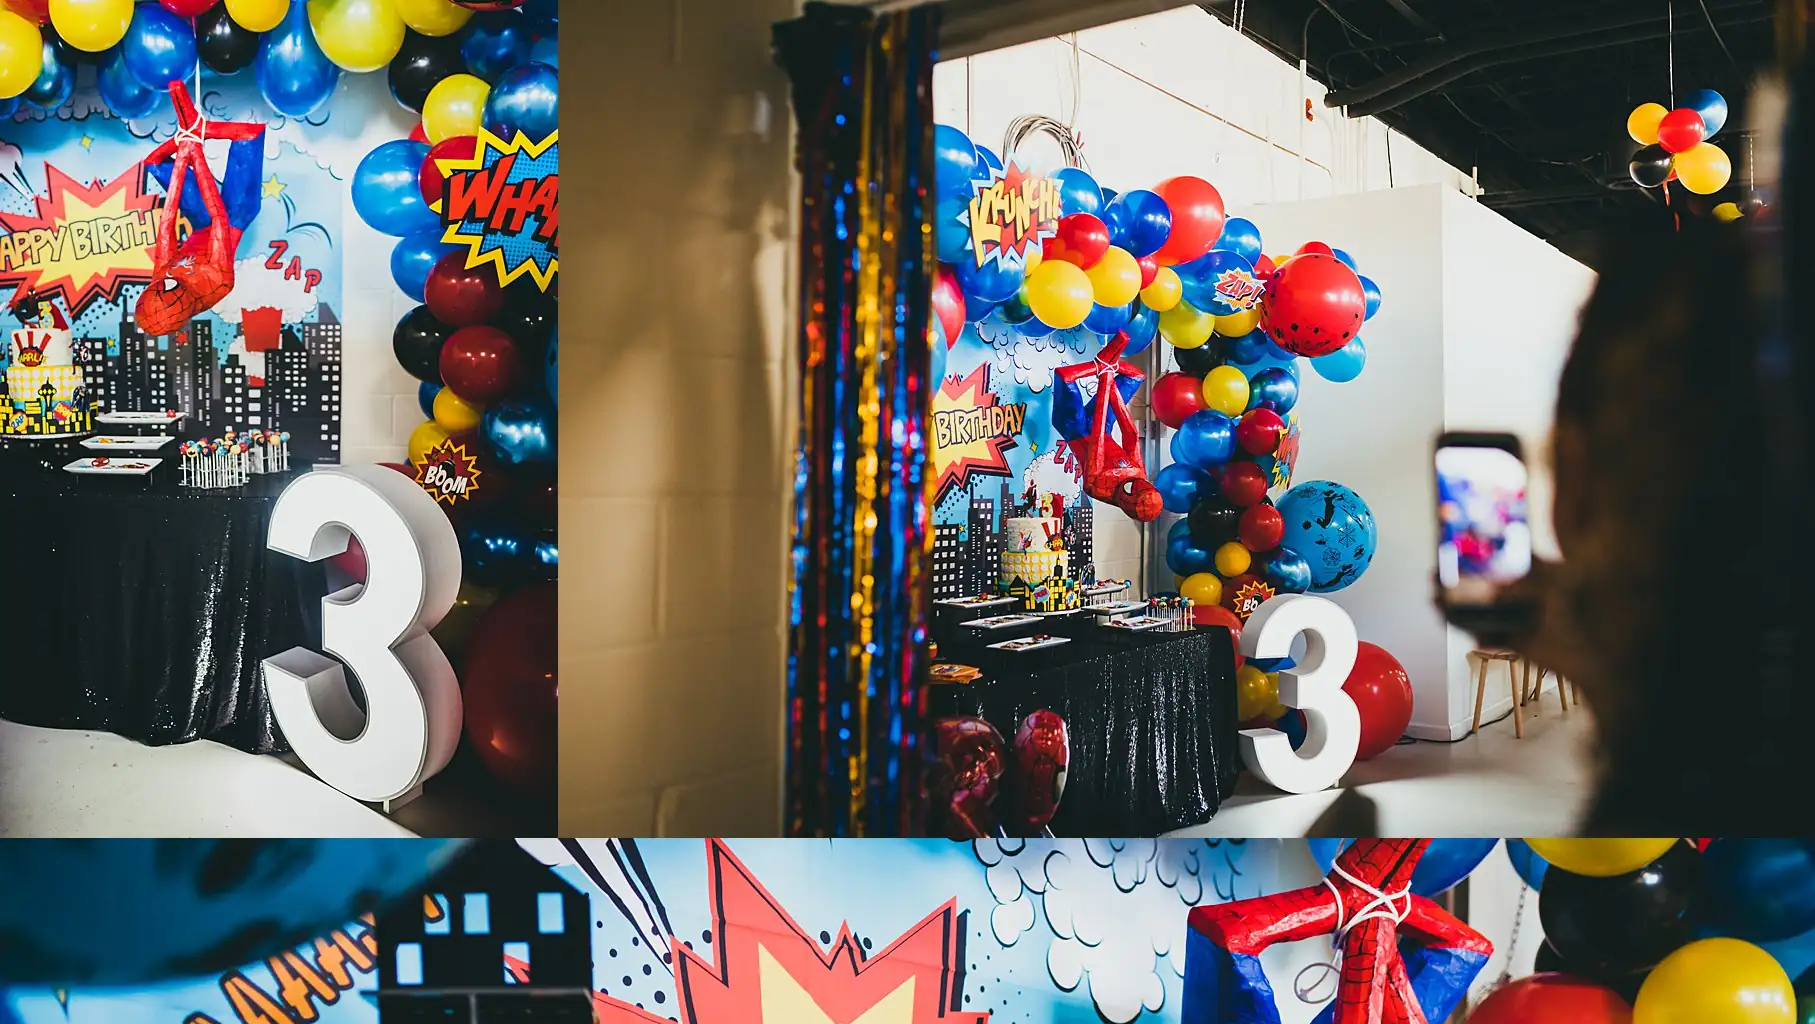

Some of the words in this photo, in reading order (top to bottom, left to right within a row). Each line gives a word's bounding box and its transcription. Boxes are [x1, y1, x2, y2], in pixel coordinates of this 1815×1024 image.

[444, 154, 558, 250] WHA
[968, 177, 1061, 270] KRUNCH!
[265, 240, 322, 294] ZAP
[1215, 272, 1264, 310] ZAP!
[934, 402, 1027, 449] BIRTHDAY
[424, 464, 468, 494] BOOM
[1053, 440, 1083, 484] ZAP
[262, 465, 450, 803] 3
[1241, 594, 1361, 794] 3
